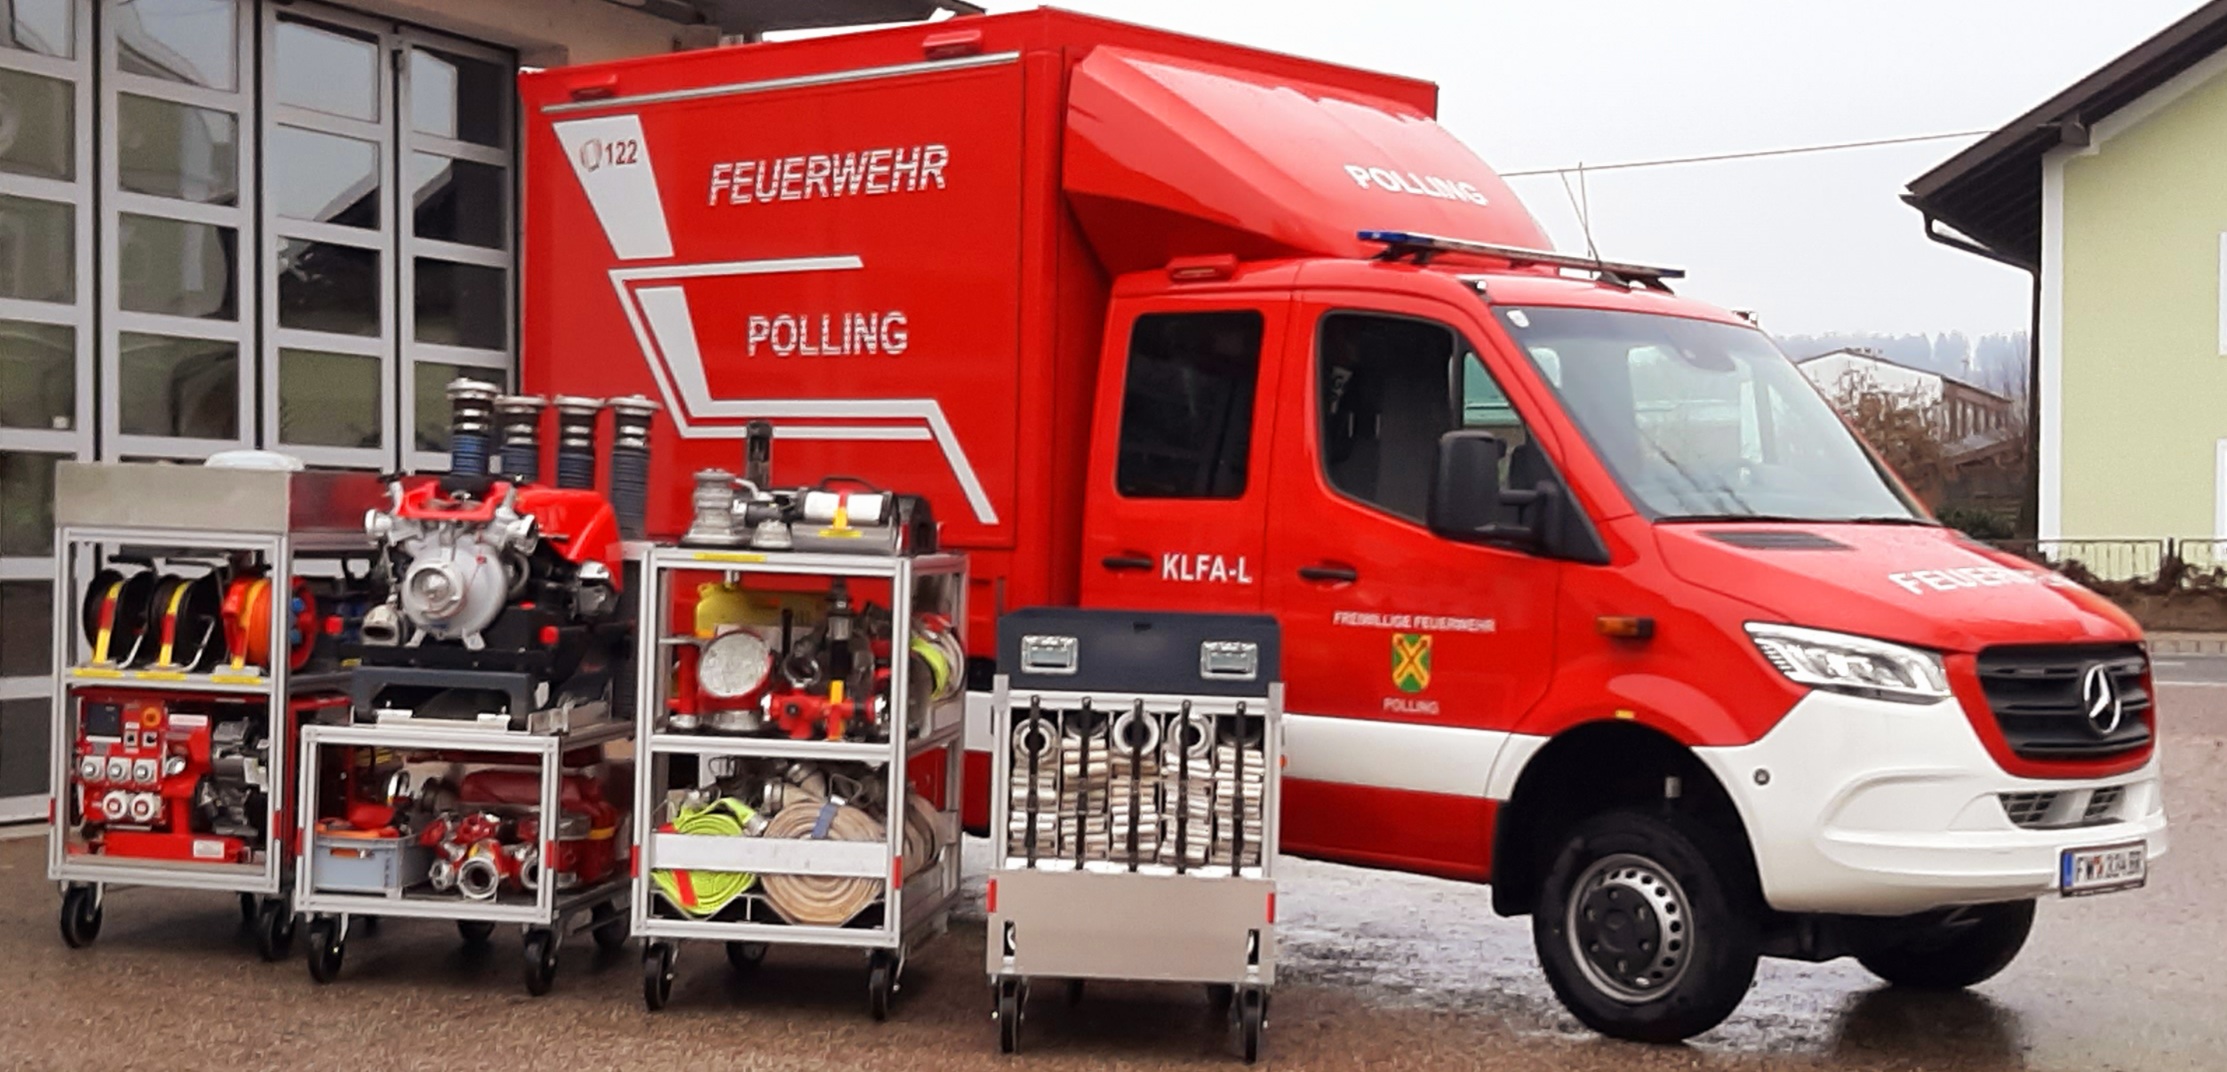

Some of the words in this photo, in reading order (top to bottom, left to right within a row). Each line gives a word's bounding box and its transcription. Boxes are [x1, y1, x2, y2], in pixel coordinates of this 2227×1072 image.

[605, 139, 638, 166] 122
[707, 144, 949, 206] FEUERWEHR
[1343, 163, 1489, 206] POLLING
[747, 310, 909, 357] POLLING
[1162, 552, 1253, 584] KLFA-L
[1383, 697, 1440, 715] POLLING
